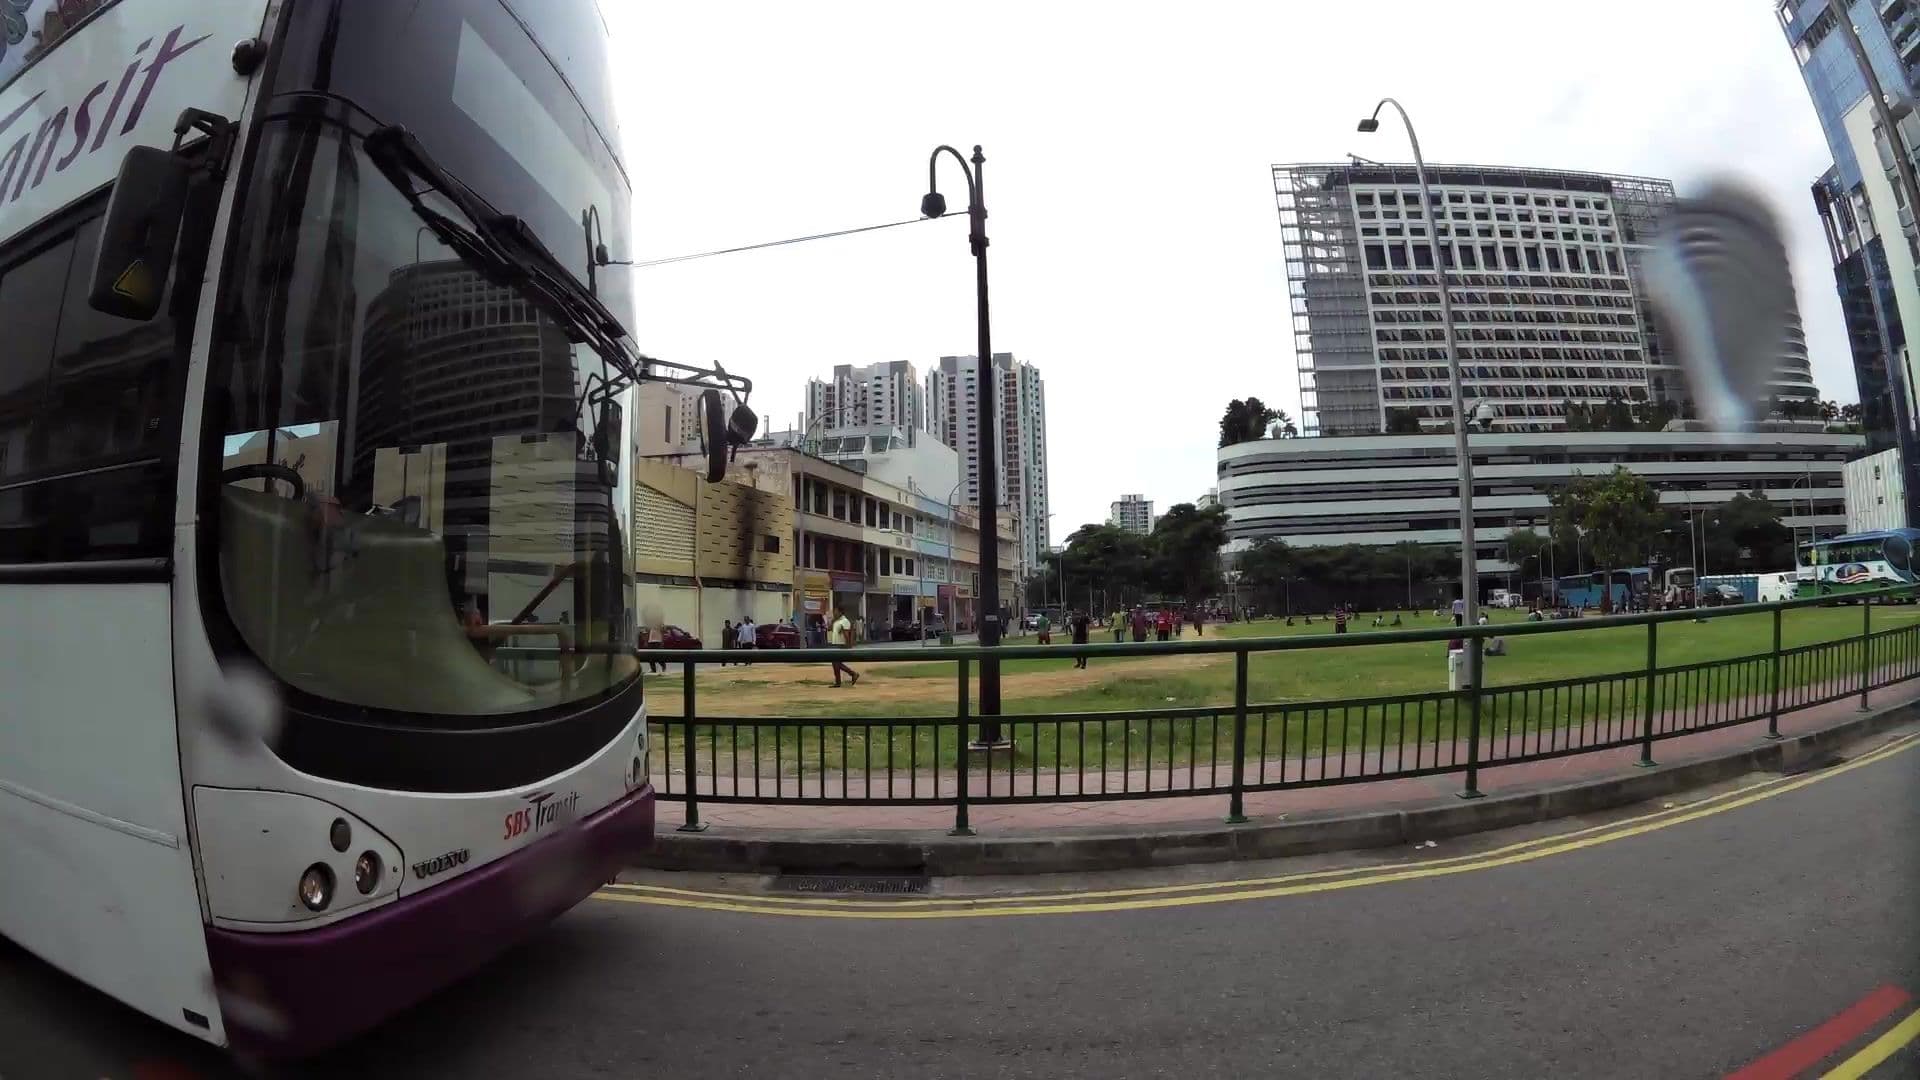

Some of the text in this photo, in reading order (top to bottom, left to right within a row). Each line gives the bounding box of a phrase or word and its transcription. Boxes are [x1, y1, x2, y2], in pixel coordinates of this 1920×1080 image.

[0, 24, 213, 202] ansit
[504, 791, 582, 840] SBS Transit
[412, 848, 471, 879] VOLVO
